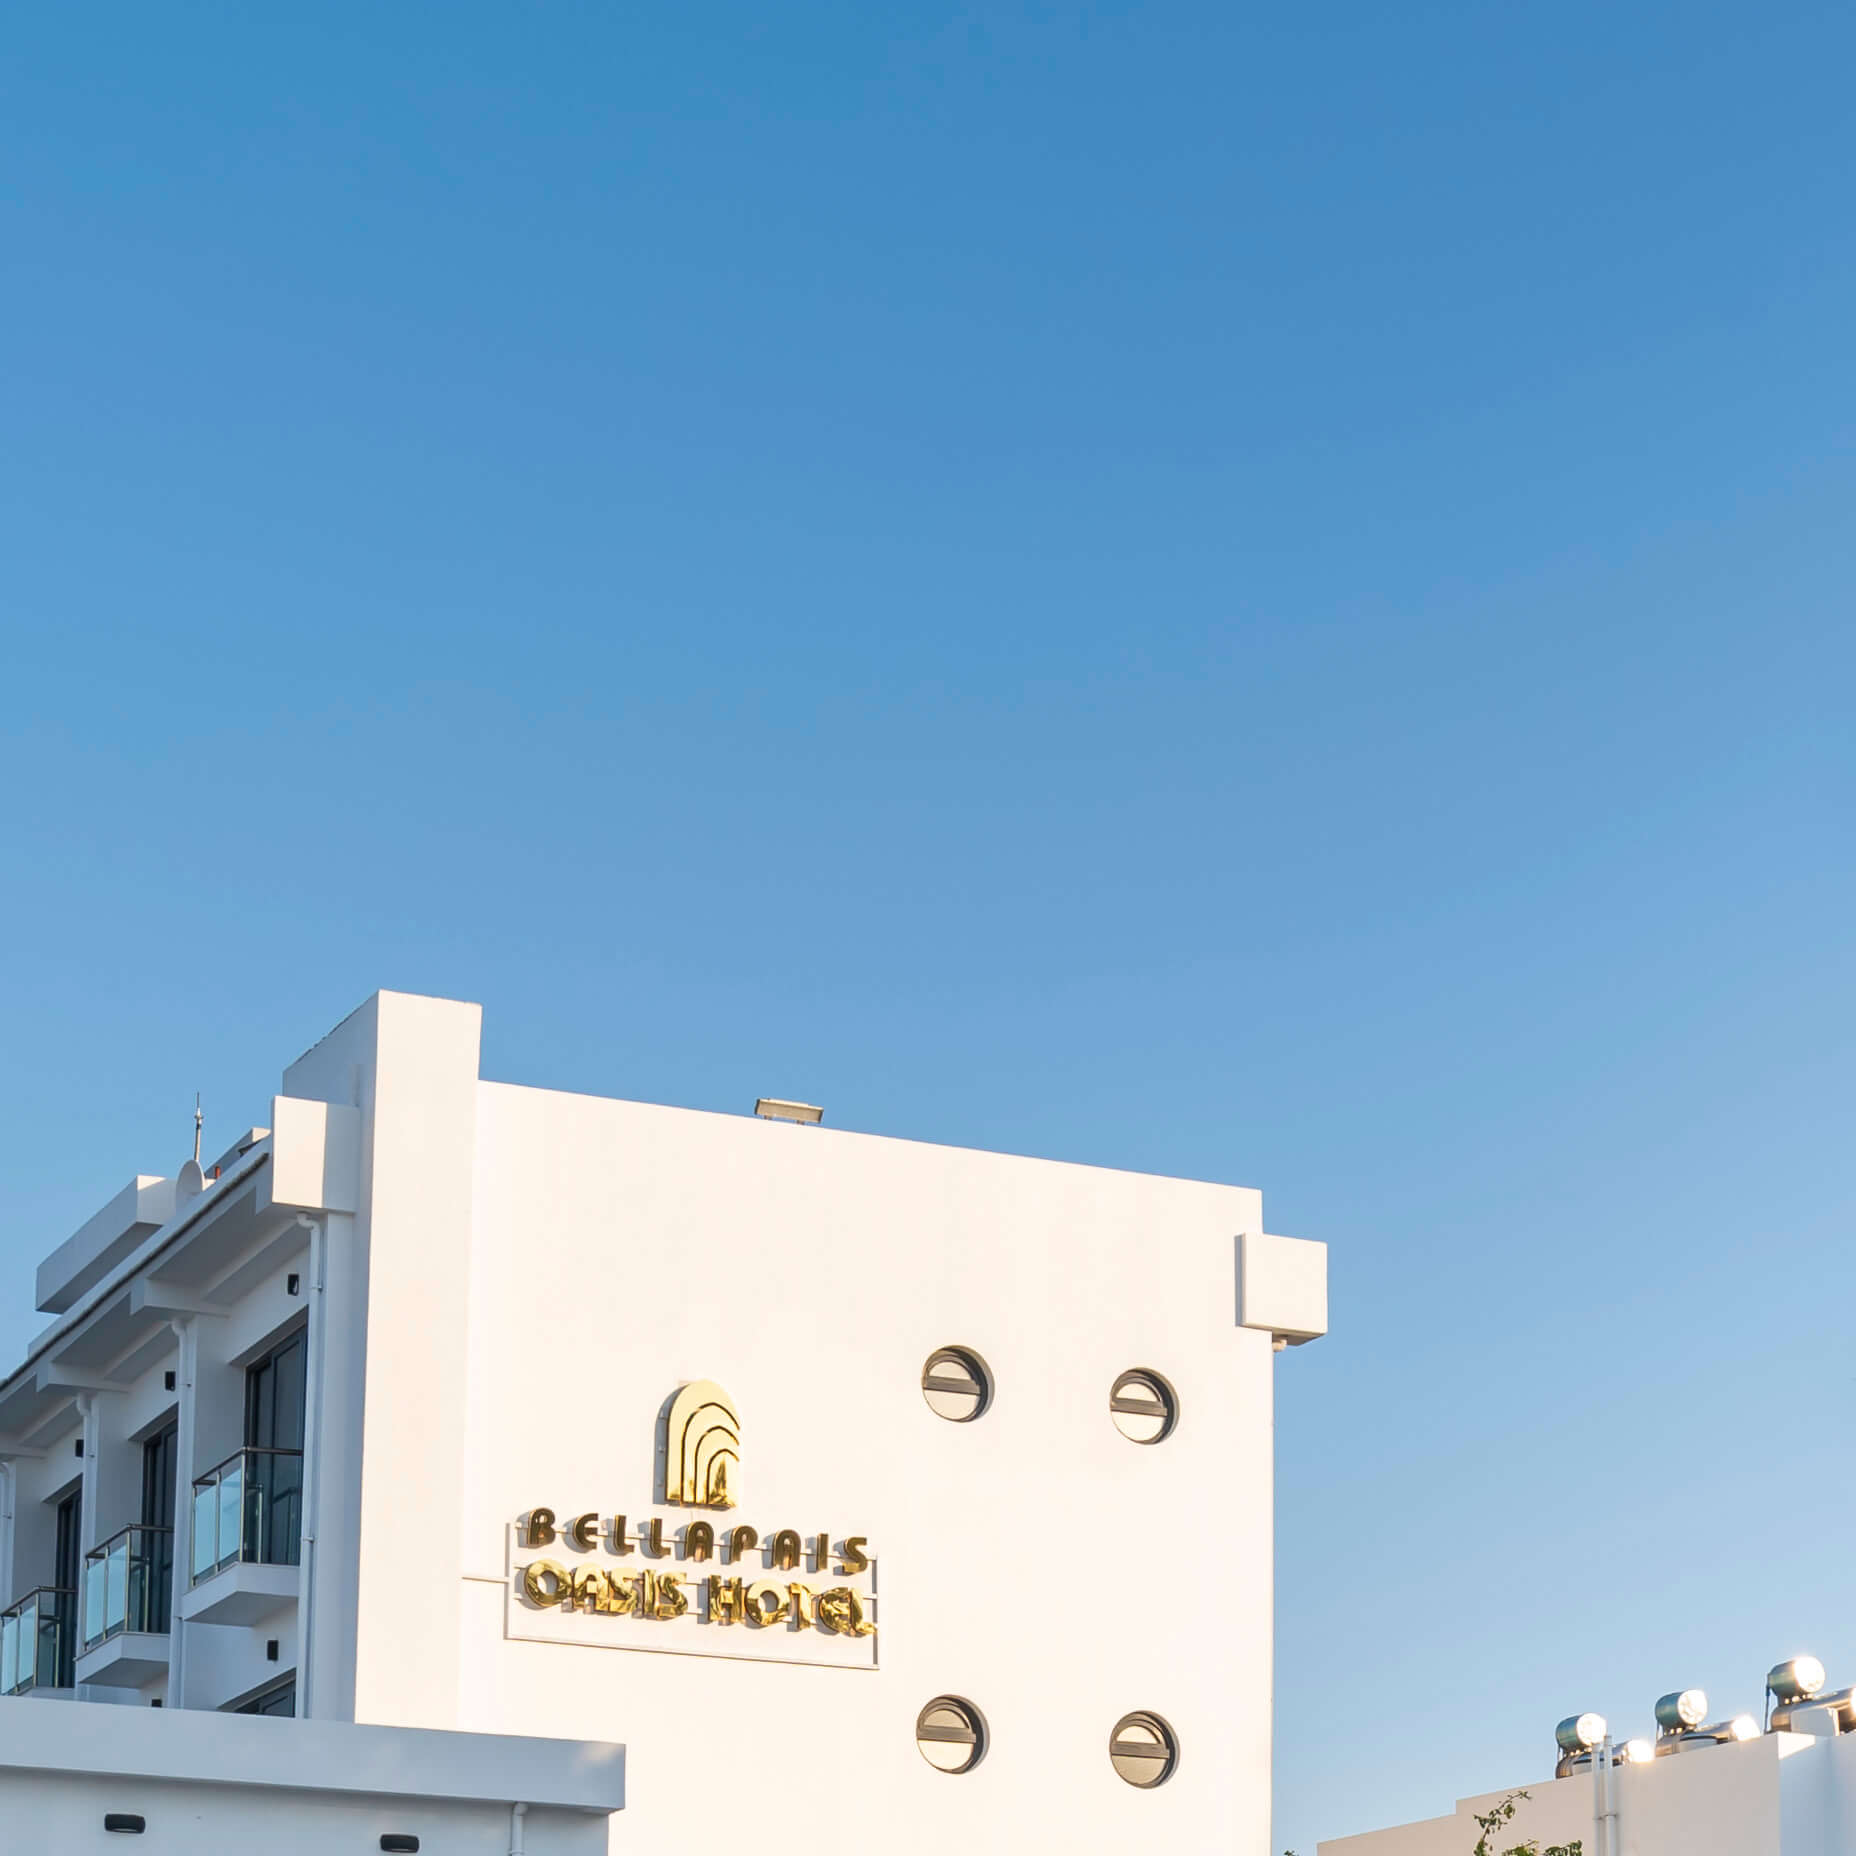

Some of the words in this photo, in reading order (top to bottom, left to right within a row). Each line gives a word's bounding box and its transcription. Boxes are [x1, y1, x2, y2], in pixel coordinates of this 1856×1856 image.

[526, 1507, 868, 1576] BELLAPAIS
[523, 1559, 689, 1620] OASIS
[707, 1574, 878, 1637] HOTEL
